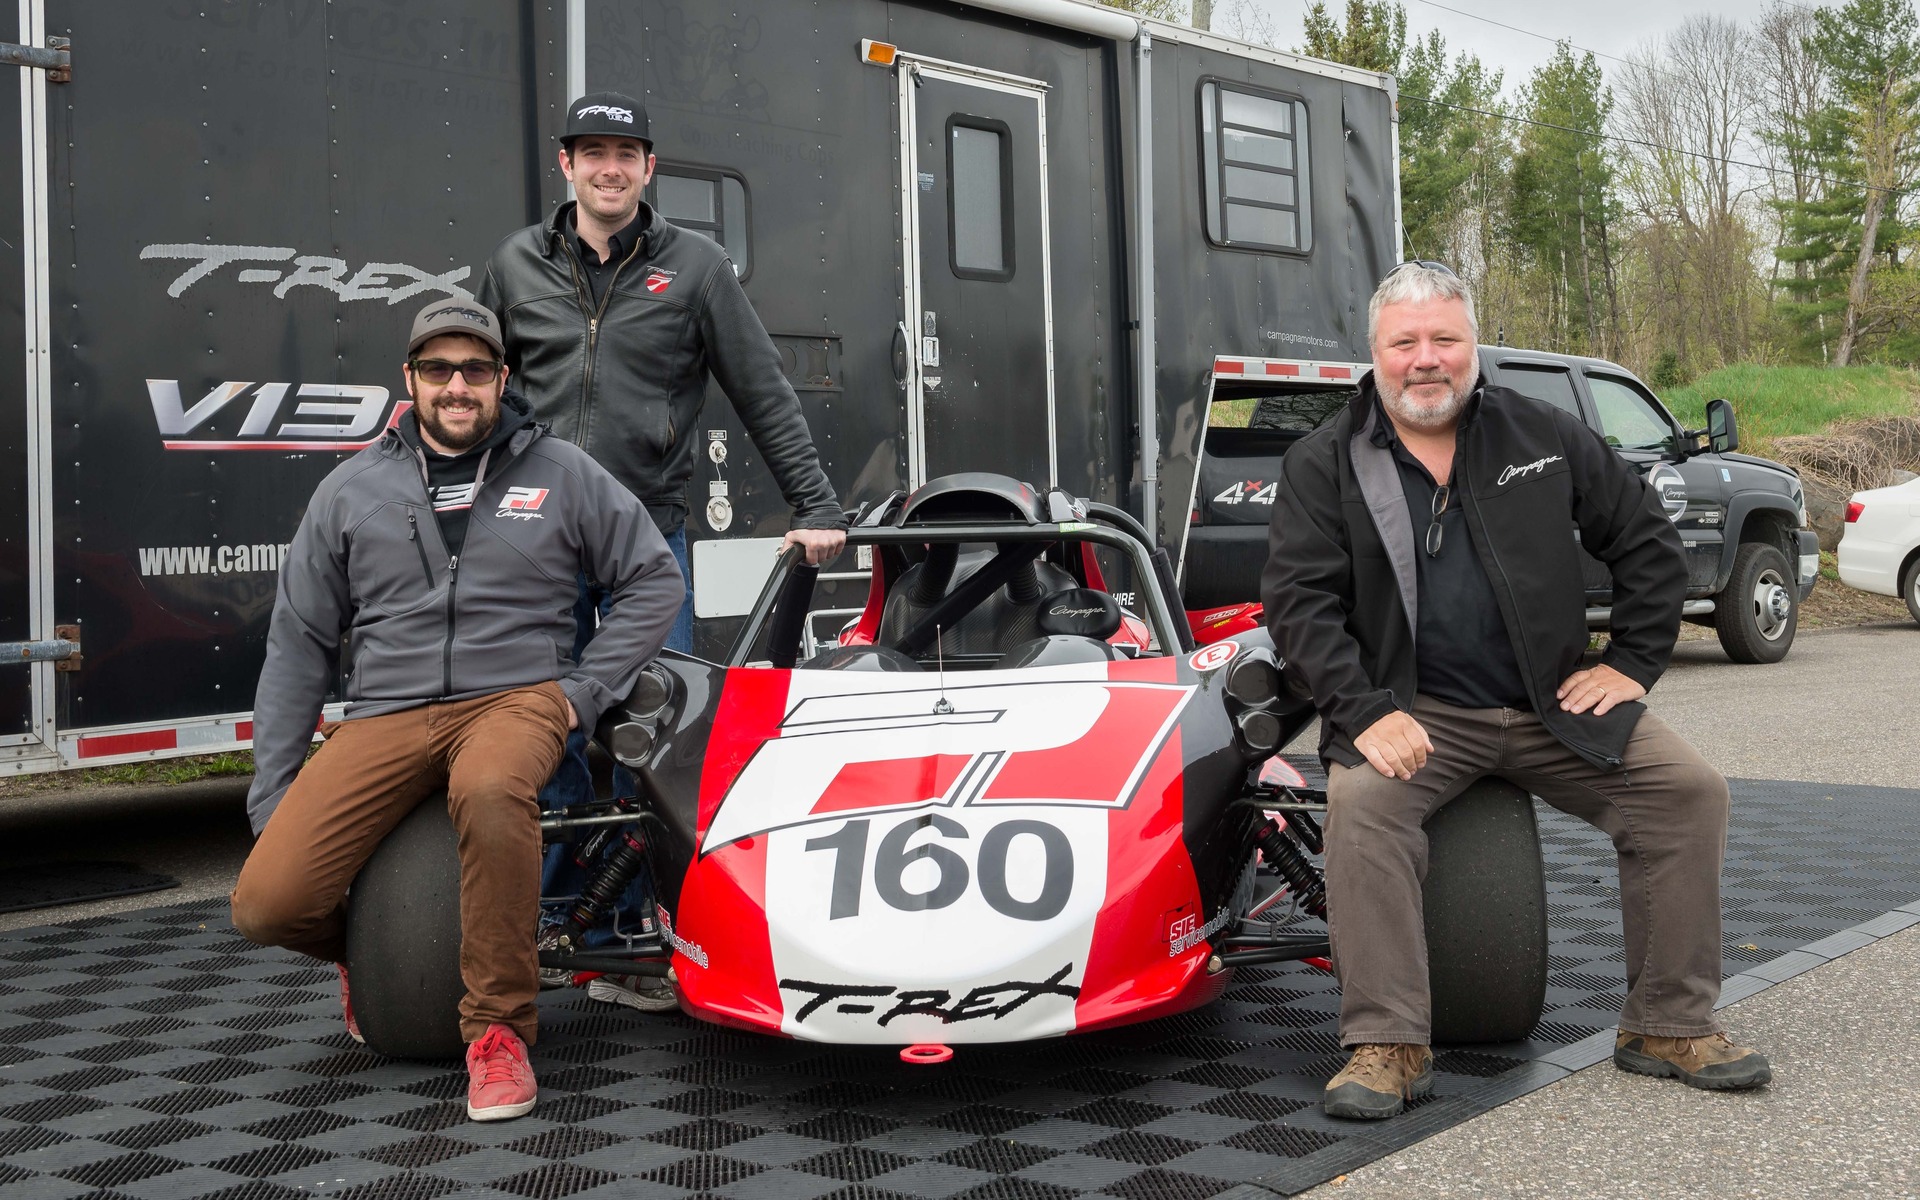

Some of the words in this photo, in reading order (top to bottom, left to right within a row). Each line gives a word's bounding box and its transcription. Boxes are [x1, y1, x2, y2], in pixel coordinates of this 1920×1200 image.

[577, 105, 633, 119] T-REX
[139, 243, 475, 305] T-REX
[1267, 330, 1338, 348] campagnamotors.com
[1497, 455, 1563, 485] Campagna
[496, 508, 544, 521] Campagna
[1112, 592, 1135, 606] HIRE
[1050, 605, 1106, 618] Campagna
[805, 813, 1074, 921] 160
[1169, 906, 1230, 957] servicemobile
[779, 962, 1080, 1027] T-REX
